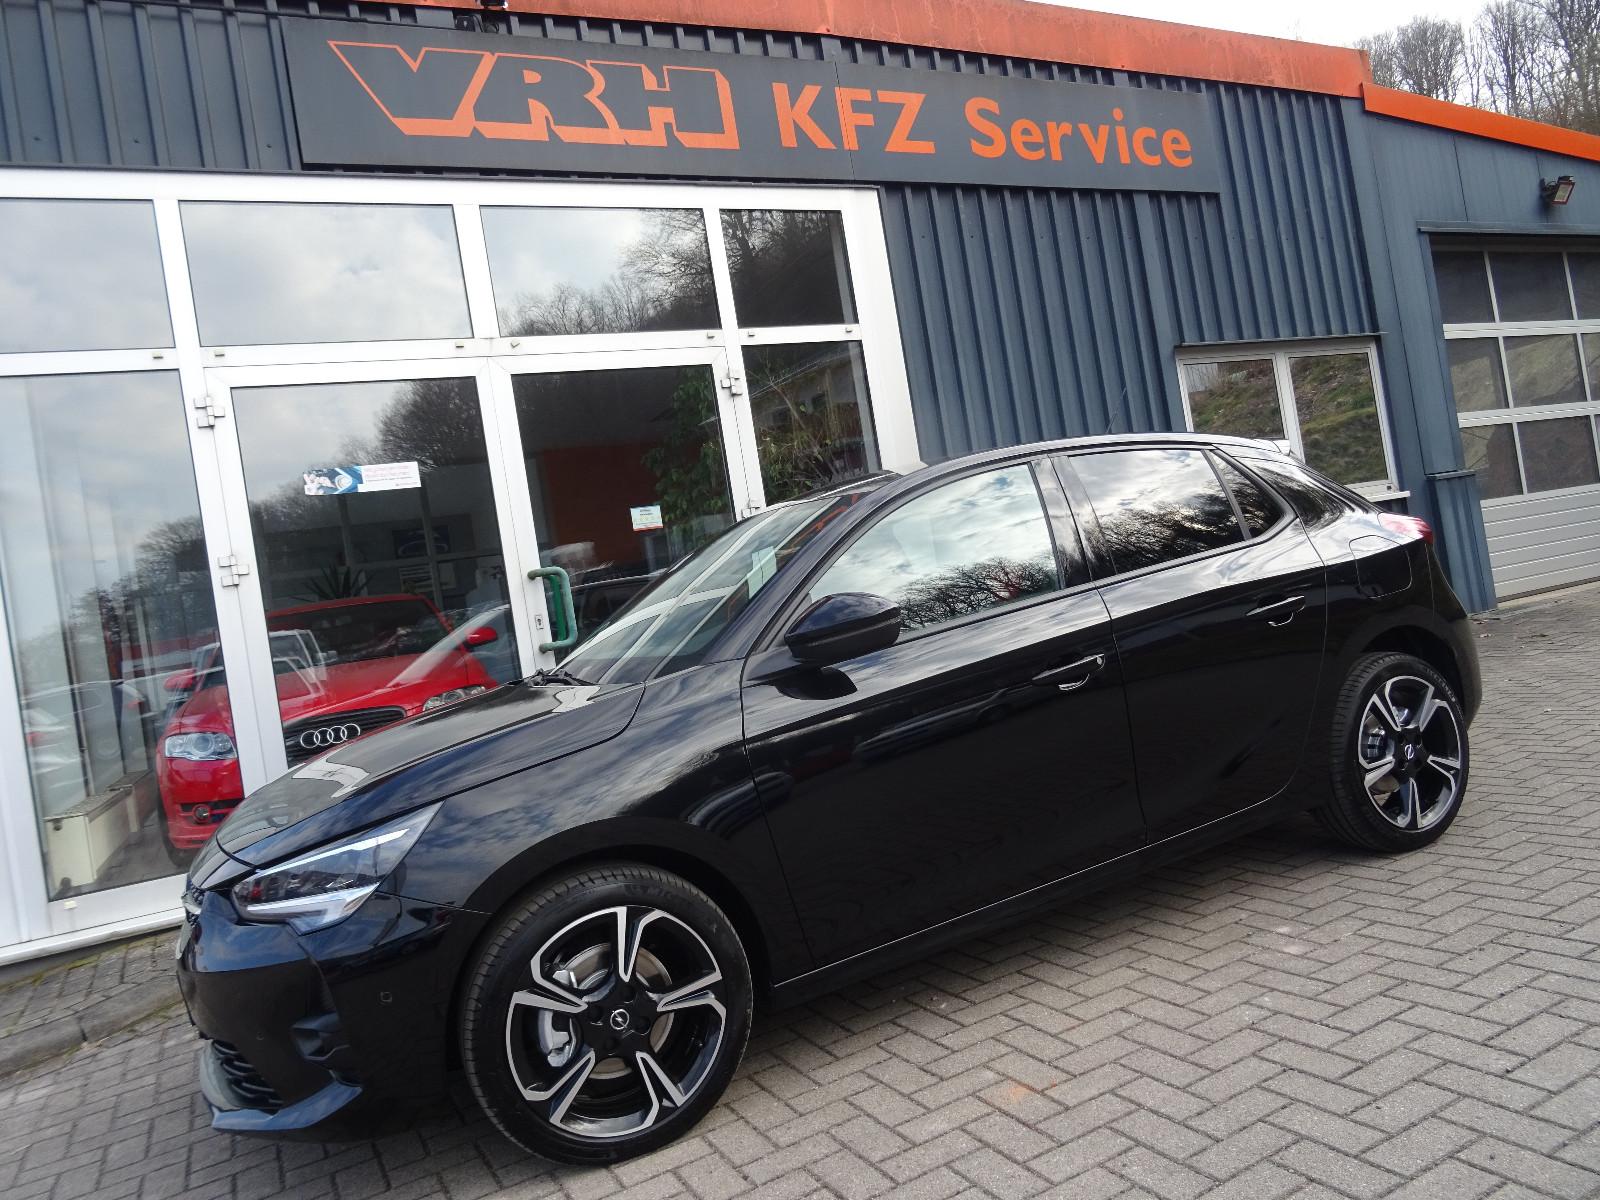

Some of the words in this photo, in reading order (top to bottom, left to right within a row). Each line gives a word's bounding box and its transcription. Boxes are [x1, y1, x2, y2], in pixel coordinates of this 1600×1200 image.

[328, 40, 740, 150] VRH
[772, 82, 936, 154] KFZ
[965, 97, 1193, 168] Service
